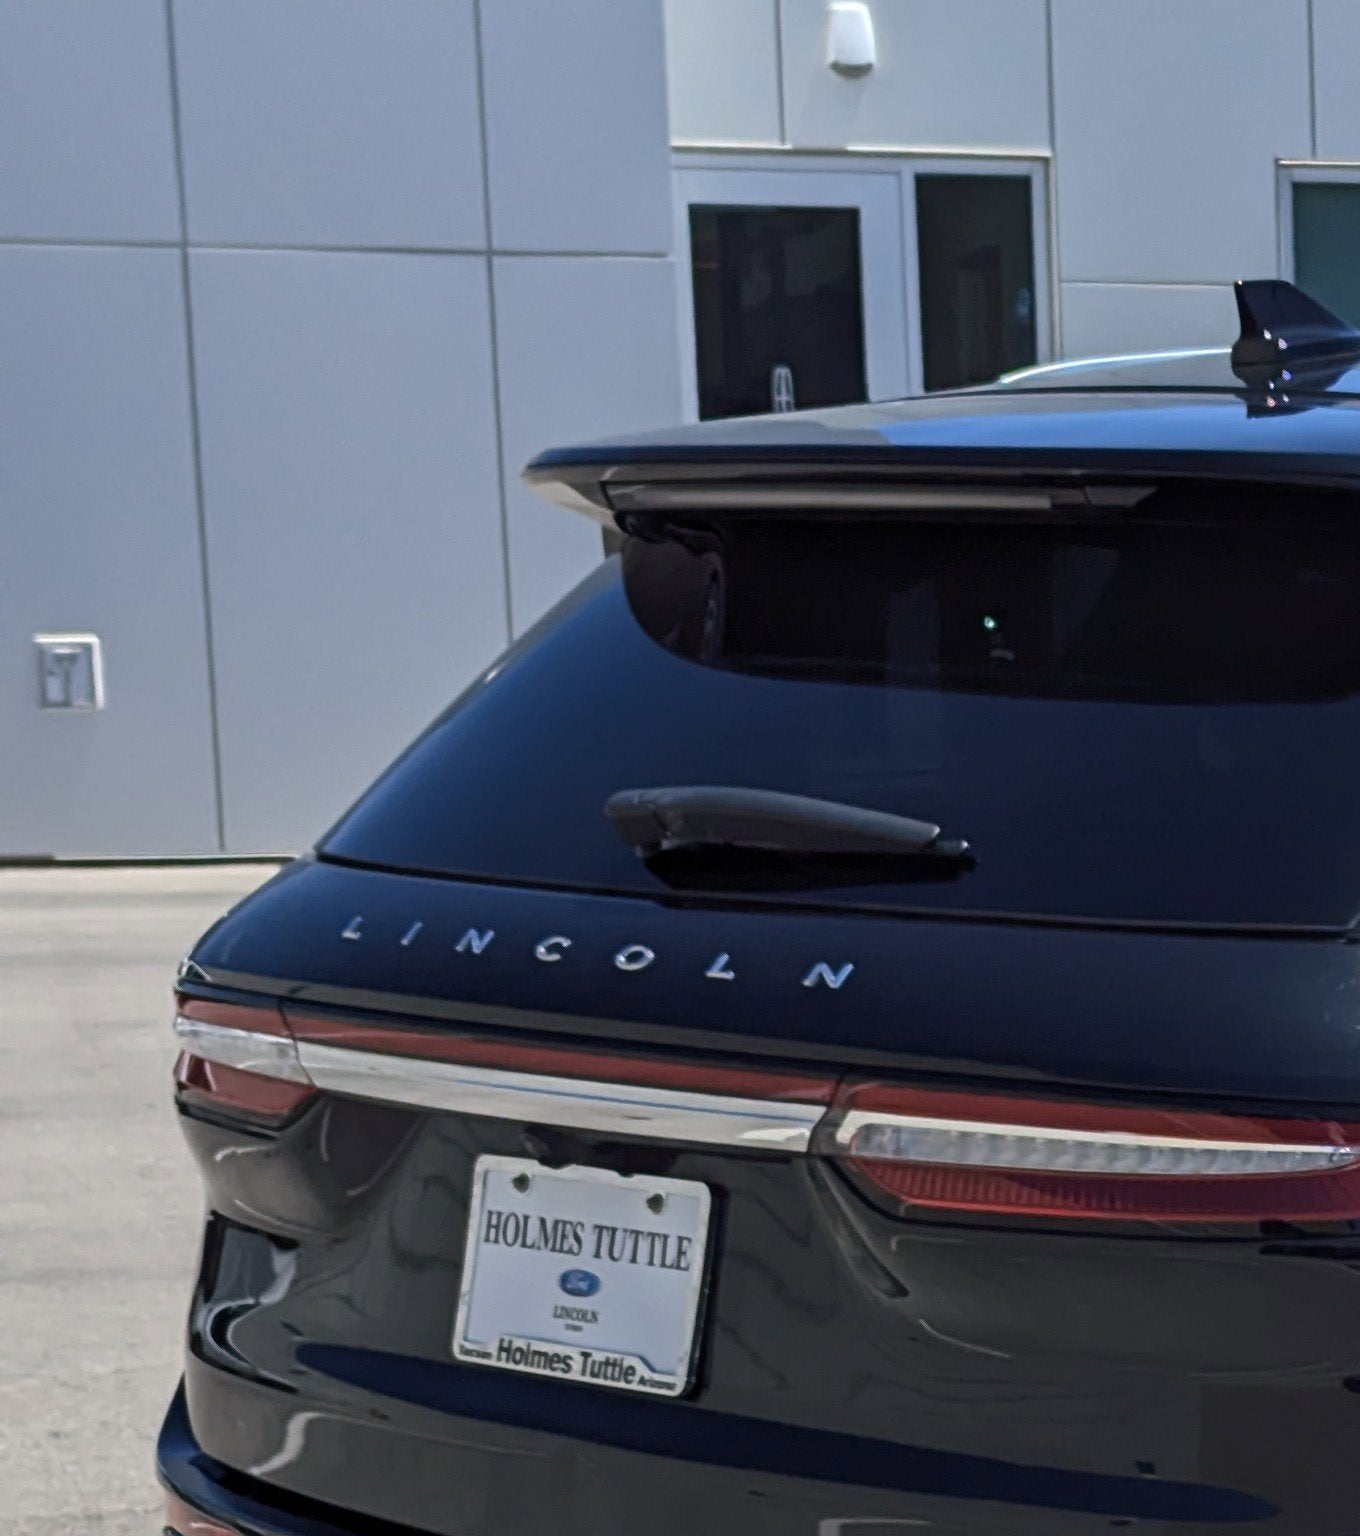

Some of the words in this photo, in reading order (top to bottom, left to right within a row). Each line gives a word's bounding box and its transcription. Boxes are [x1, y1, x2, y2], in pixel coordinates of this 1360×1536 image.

[340, 915, 857, 990] LINCOLN
[484, 1210, 584, 1256] HOLMES
[593, 1224, 692, 1271] TUTTLE
[552, 1305, 599, 1324] LINCOLN
[497, 1338, 574, 1374] Holmes
[580, 1351, 637, 1384] Tuttle
